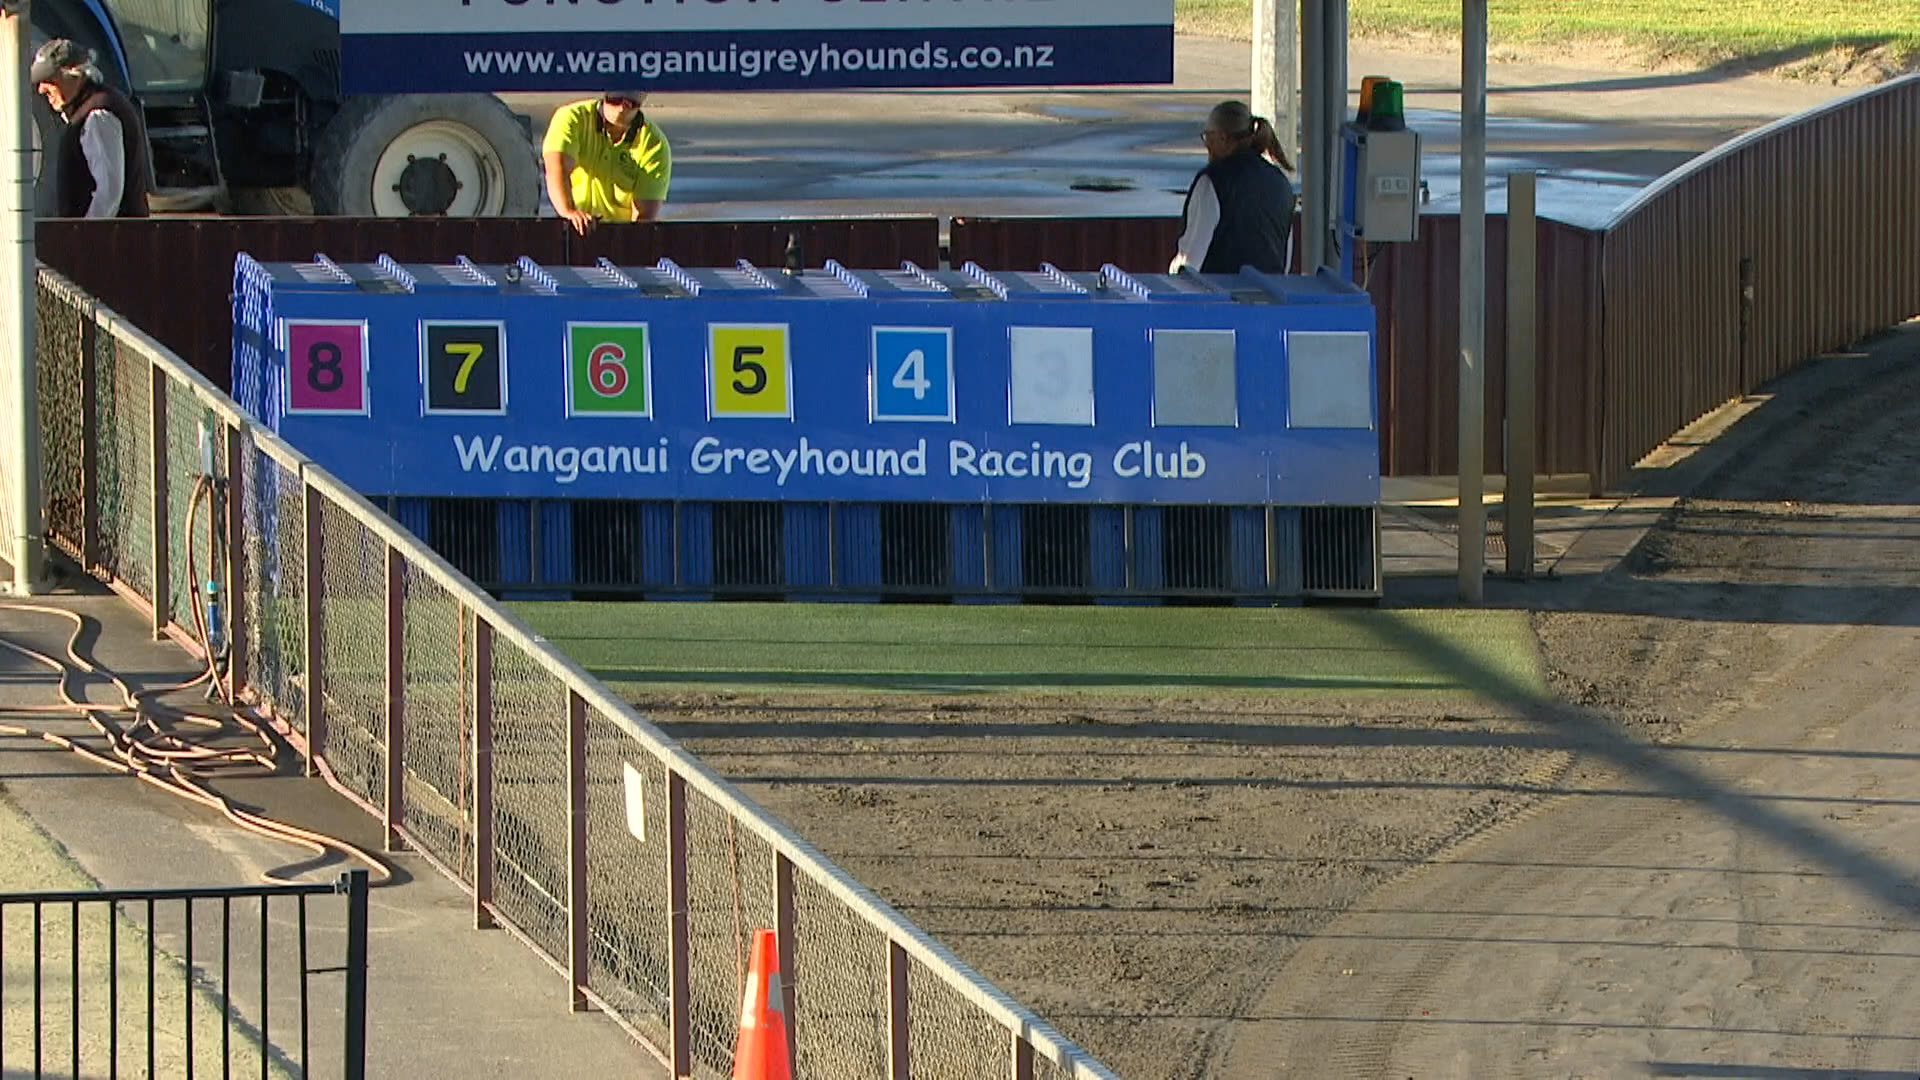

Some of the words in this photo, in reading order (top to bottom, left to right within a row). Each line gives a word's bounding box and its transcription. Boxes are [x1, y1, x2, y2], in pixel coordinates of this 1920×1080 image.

[463, 41, 1055, 78] www.wanganuigreyhounds.co.nz
[306, 341, 344, 393] 8
[444, 342, 484, 394] 7
[586, 342, 628, 398] 6
[731, 345, 767, 395] 5
[891, 348, 931, 400] 4
[1033, 348, 1069, 398] 3
[453, 434, 668, 483] Wanganui
[690, 436, 927, 486] Greyhound
[949, 440, 1093, 489] Racing
[1113, 440, 1207, 479] Club
